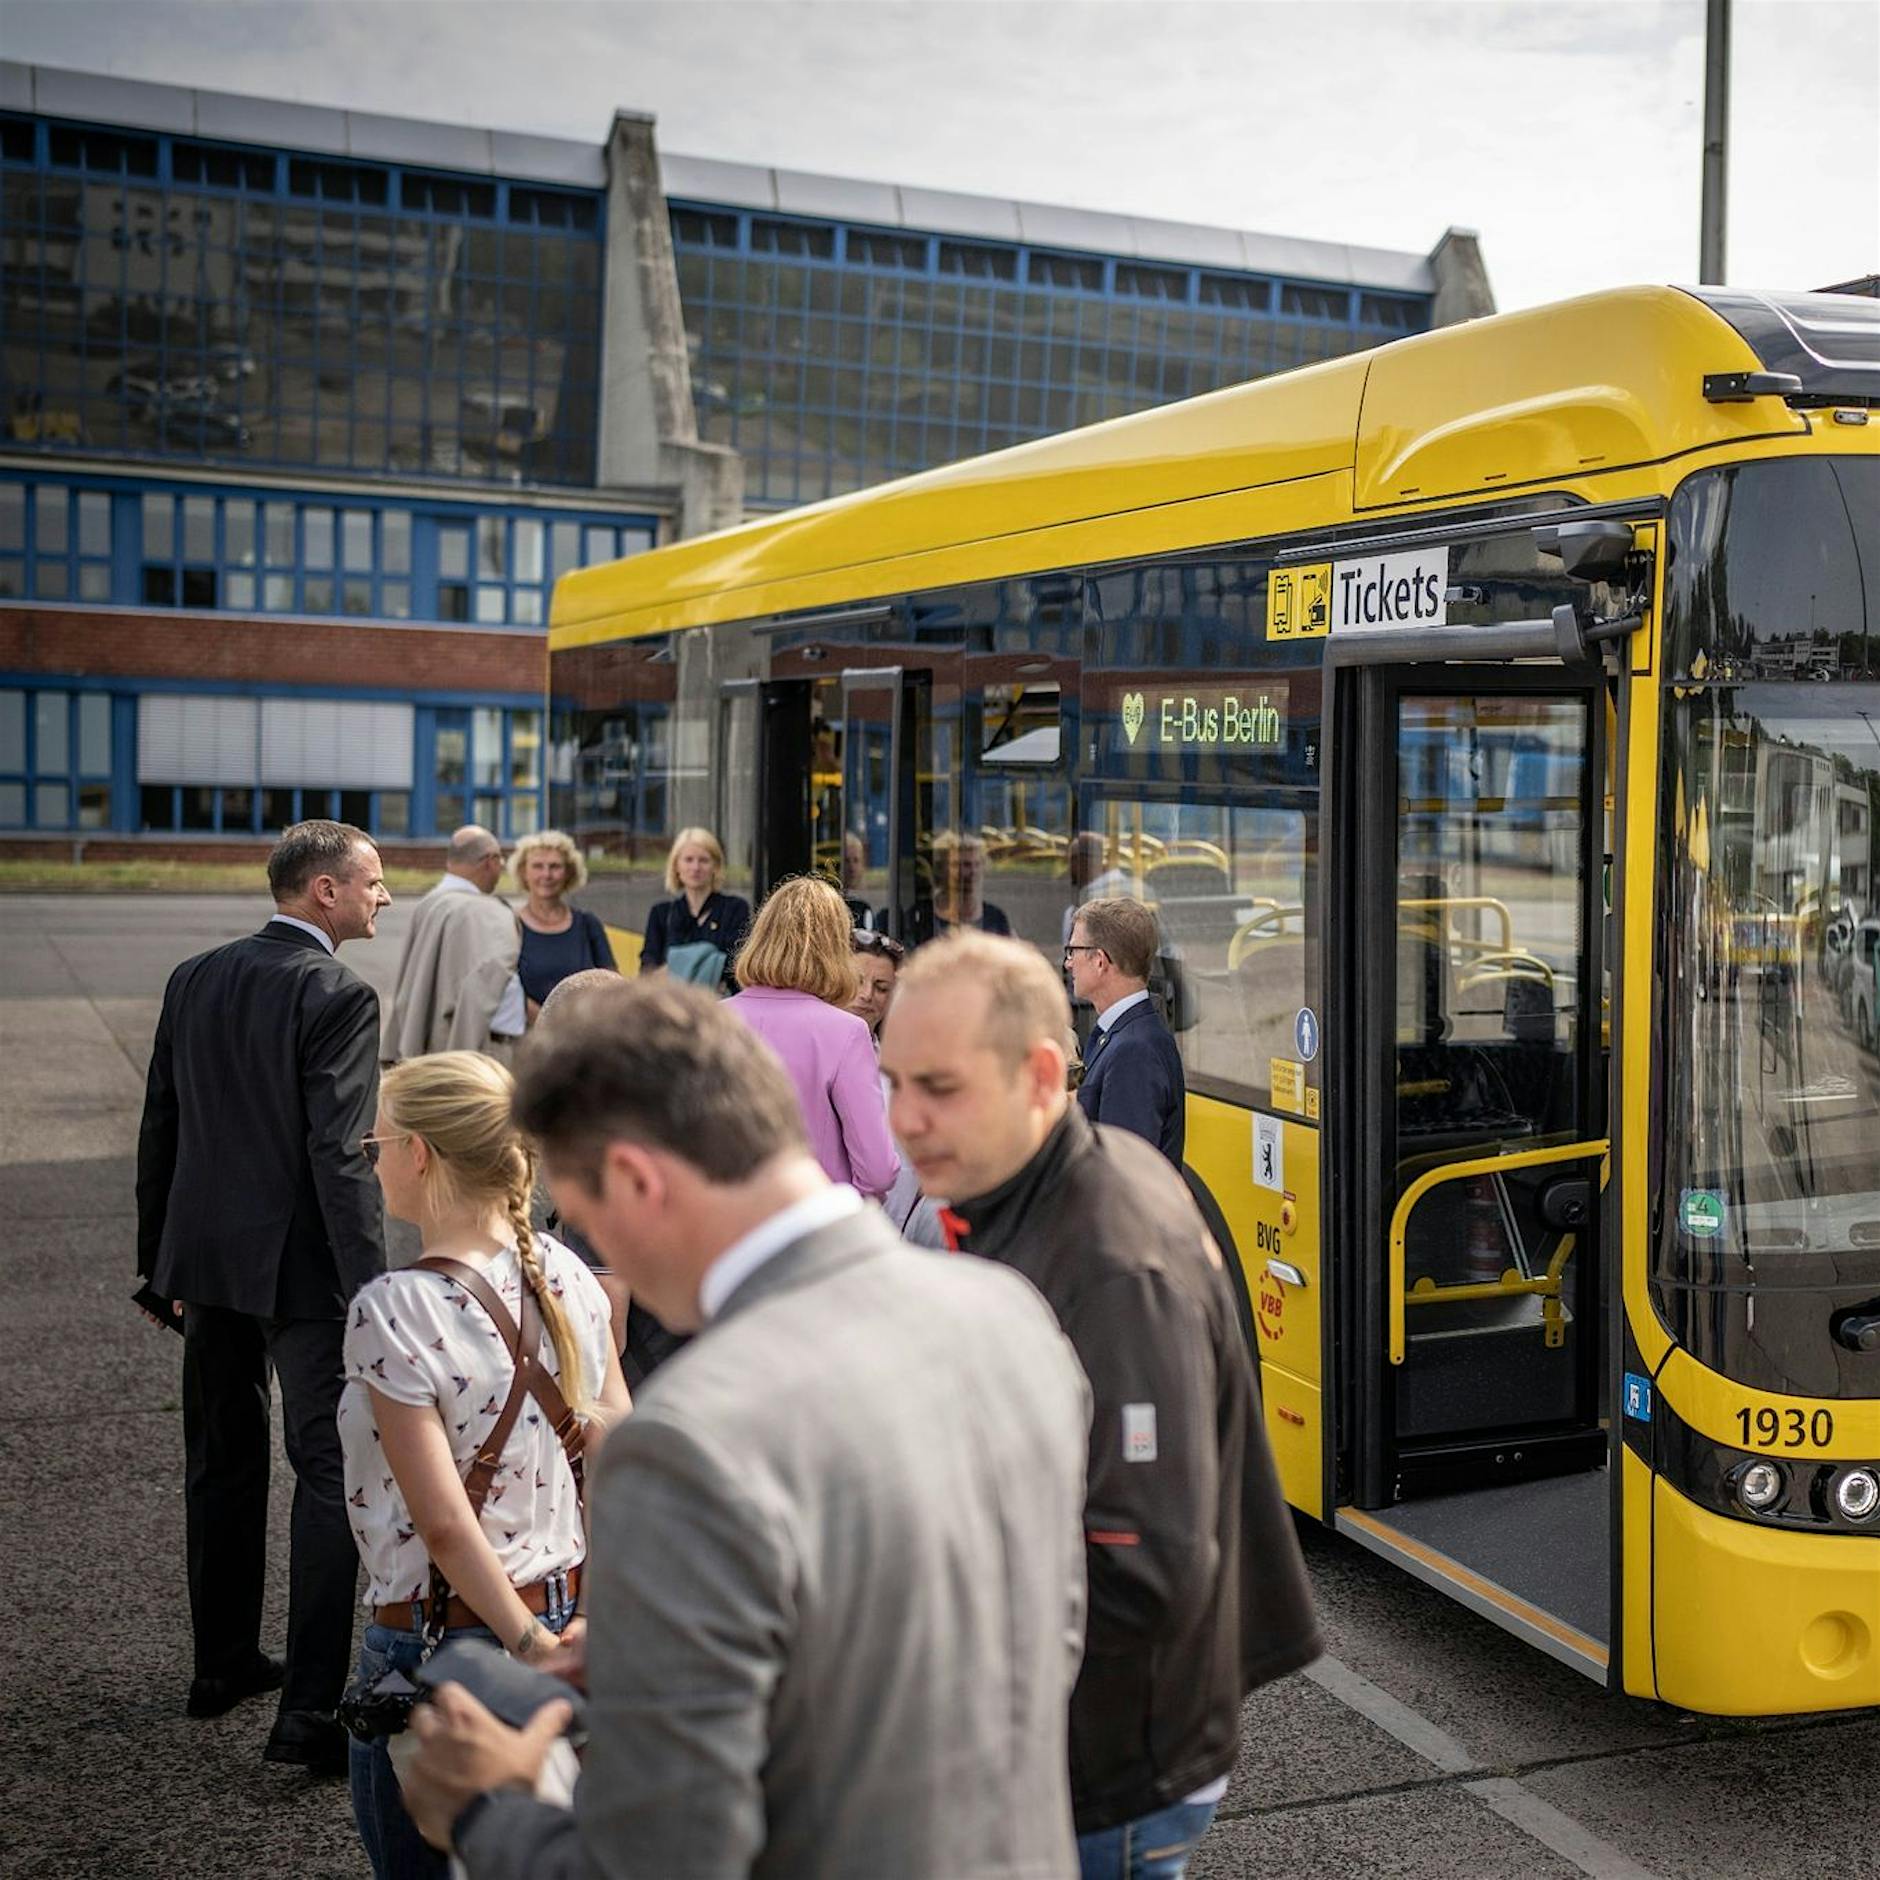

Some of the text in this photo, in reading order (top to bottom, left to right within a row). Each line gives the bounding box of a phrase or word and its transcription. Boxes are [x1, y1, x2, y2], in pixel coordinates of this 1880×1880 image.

[1340, 563, 1439, 625] Tickets
[1160, 696, 1280, 743] E-Bus Berlin
[1697, 1196, 1708, 1214] 4
[1257, 1221, 1281, 1255] BVG
[1260, 1290, 1283, 1318] VBB
[1736, 1407, 1834, 1448] 1930
